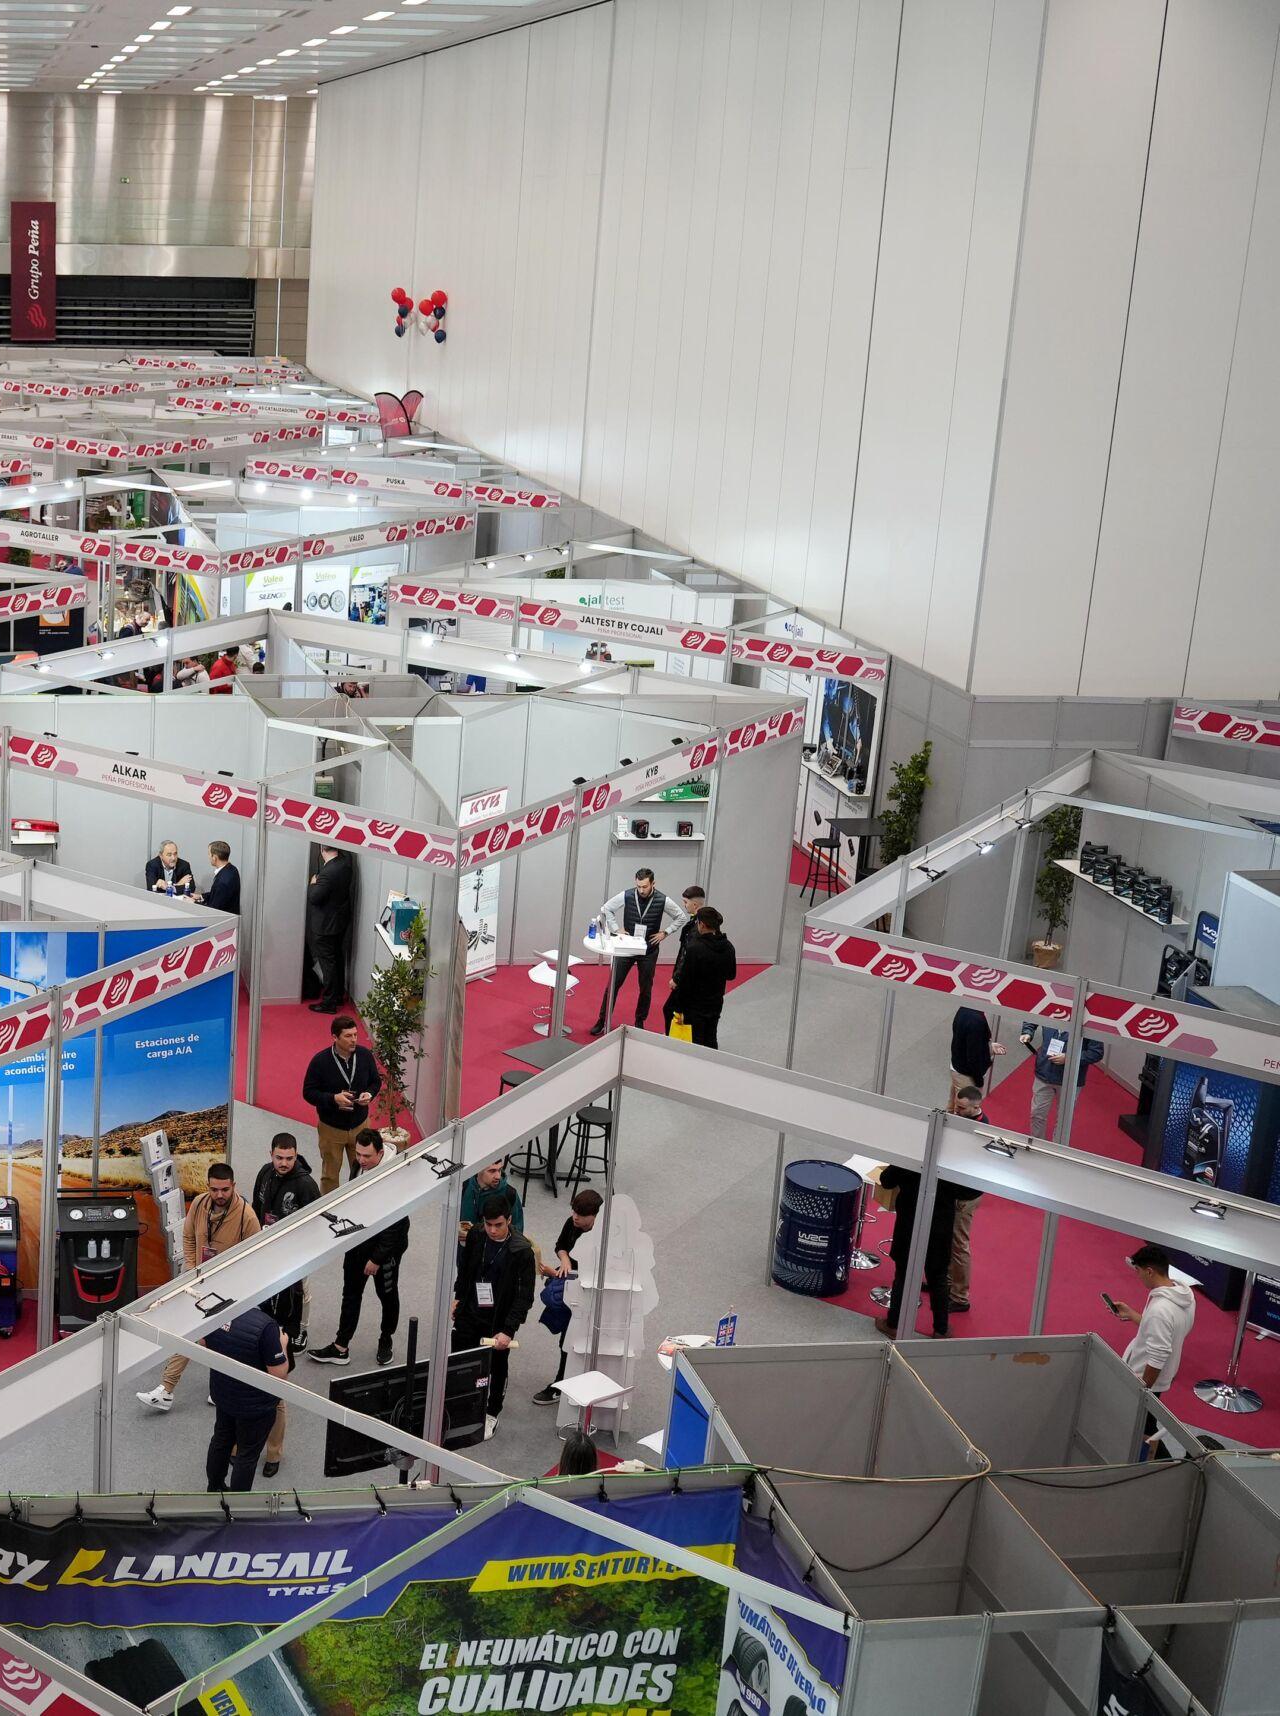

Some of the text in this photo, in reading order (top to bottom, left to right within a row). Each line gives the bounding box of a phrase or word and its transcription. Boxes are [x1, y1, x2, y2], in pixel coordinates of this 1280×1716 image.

[27, 219, 42, 300] Grupo Peña
[386, 477, 405, 486] PUSKA
[20, 530, 59, 542] AGROTALLER
[349, 533, 364, 543] VALEO
[579, 615, 664, 636] JALTEST BY COJALI
[111, 764, 147, 780] ALKAR
[645, 765, 659, 779] KYB
[117, 776, 156, 793] PROFESIONAL
[469, 793, 501, 815] KYB
[135, 1033, 200, 1049] Estaciones de
[146, 1045, 192, 1060] carga A/A
[797, 1230, 830, 1243] WRC
[114, 1548, 354, 1581] LANDSAIL
[267, 1582, 348, 1597] TYRES
[420, 1626, 682, 1671] EL NEUMÁTICO CON
[418, 1663, 678, 1715] CUALIDADES
[745, 1686, 762, 1711] 990
